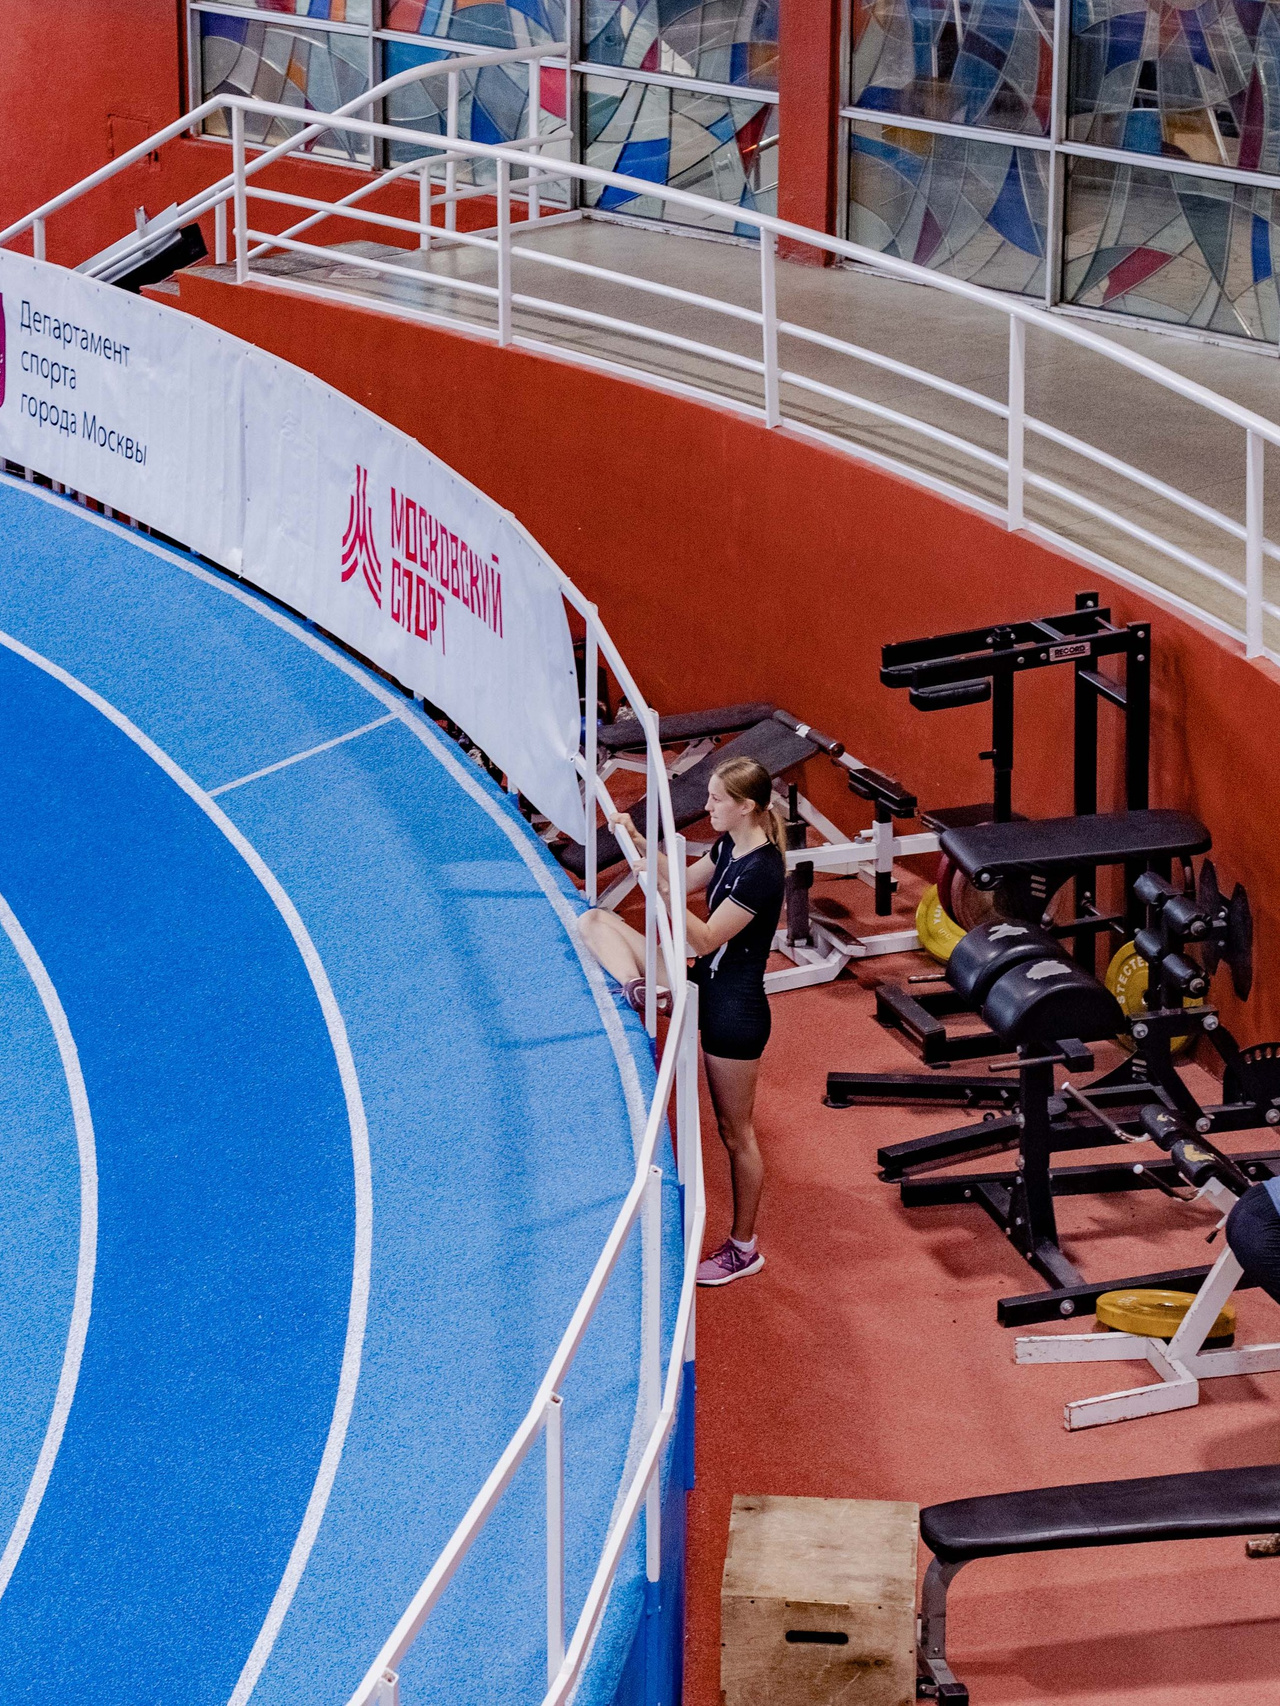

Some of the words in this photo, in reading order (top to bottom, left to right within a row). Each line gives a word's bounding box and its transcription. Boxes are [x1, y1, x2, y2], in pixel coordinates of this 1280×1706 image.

[20, 299, 130, 367] Департамент
[20, 350, 77, 390] спорта
[20, 392, 77, 438] города
[82, 410, 147, 466] Москвы
[390, 486, 503, 639] МОСКОВСКИЙ
[390, 557, 446, 656] СПОРТ
[1054, 644, 1086, 657] RECORD
